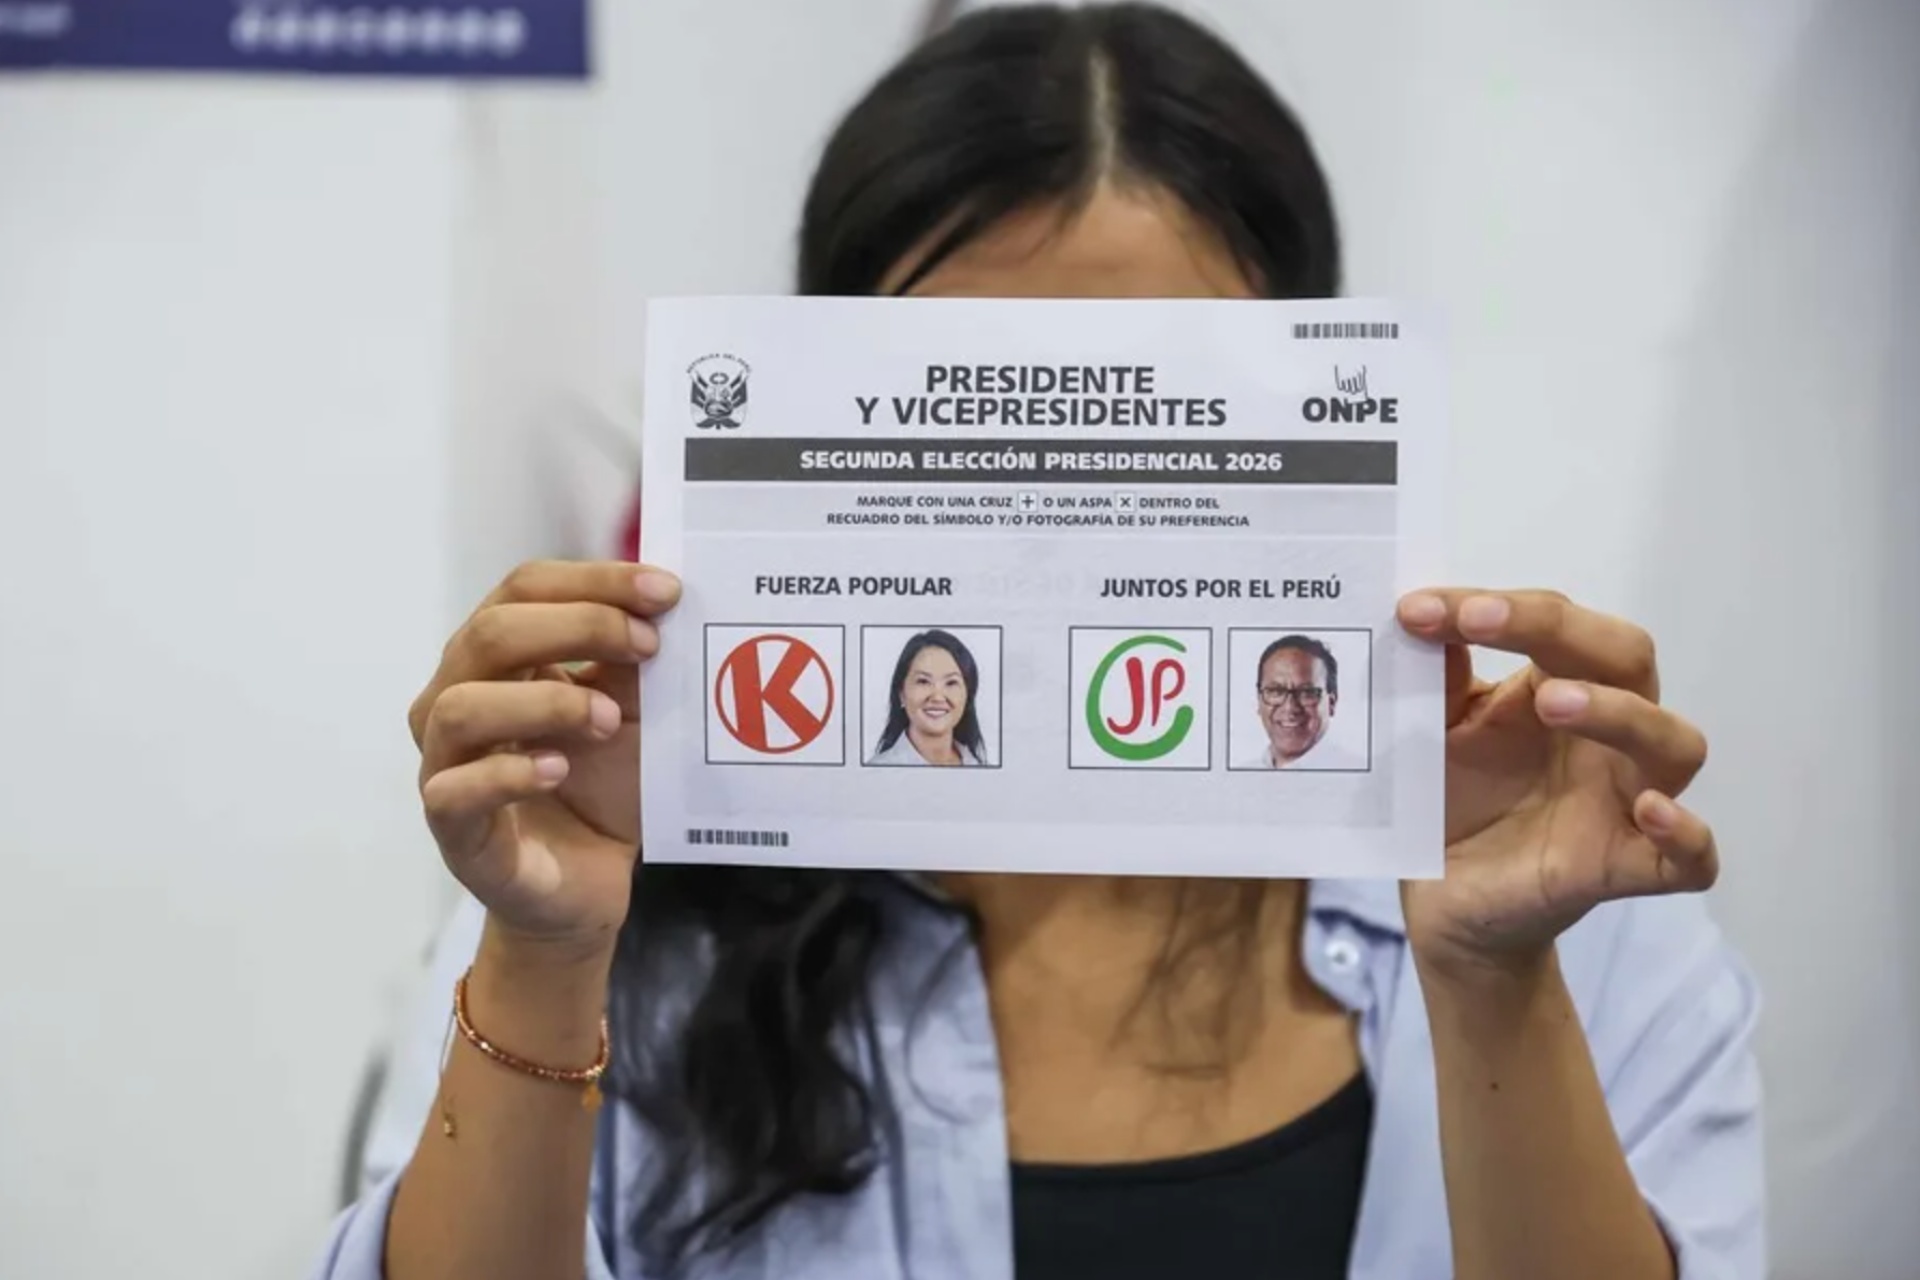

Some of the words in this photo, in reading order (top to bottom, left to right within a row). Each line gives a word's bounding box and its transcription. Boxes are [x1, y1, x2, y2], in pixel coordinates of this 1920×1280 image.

[927, 366, 1155, 394] PRESIDENTE
[856, 397, 879, 425] Y
[892, 397, 1227, 427] VICEPRESIDENTES
[1302, 397, 1398, 424] ONPE
[800, 450, 915, 469] SEGUNDA
[922, 447, 1037, 470] ELECCIÓN
[1044, 452, 1220, 471] PRESIDENCIAL
[1225, 453, 1283, 472] 2026
[857, 496, 913, 508] MARQUE
[917, 496, 945, 508] CON
[948, 496, 976, 508] UNA
[979, 496, 1013, 508] CRUZ
[1042, 497, 1055, 508] O
[1057, 497, 1076, 508] UN
[1079, 497, 1113, 508] ASPA
[1139, 497, 1193, 509] DENTRO
[1195, 498, 1220, 509] DEL
[827, 513, 901, 525] RECUADRO
[904, 514, 930, 525] DEL
[933, 512, 995, 525] SÍMBOLO
[998, 514, 1024, 526] Y/O
[1027, 513, 1114, 526] FOTOGRAFÍA
[1117, 515, 1135, 527] DE
[1139, 515, 1157, 527] SU
[1160, 515, 1250, 527] PREFERENCIA
[755, 576, 842, 596] FUERZA
[848, 577, 953, 597] POPULAR
[1100, 579, 1188, 598] JUNTOS
[1195, 579, 1242, 599] POR
[1248, 580, 1276, 599] EL
[1283, 574, 1342, 600] PERÚ
[723, 634, 829, 753] K
